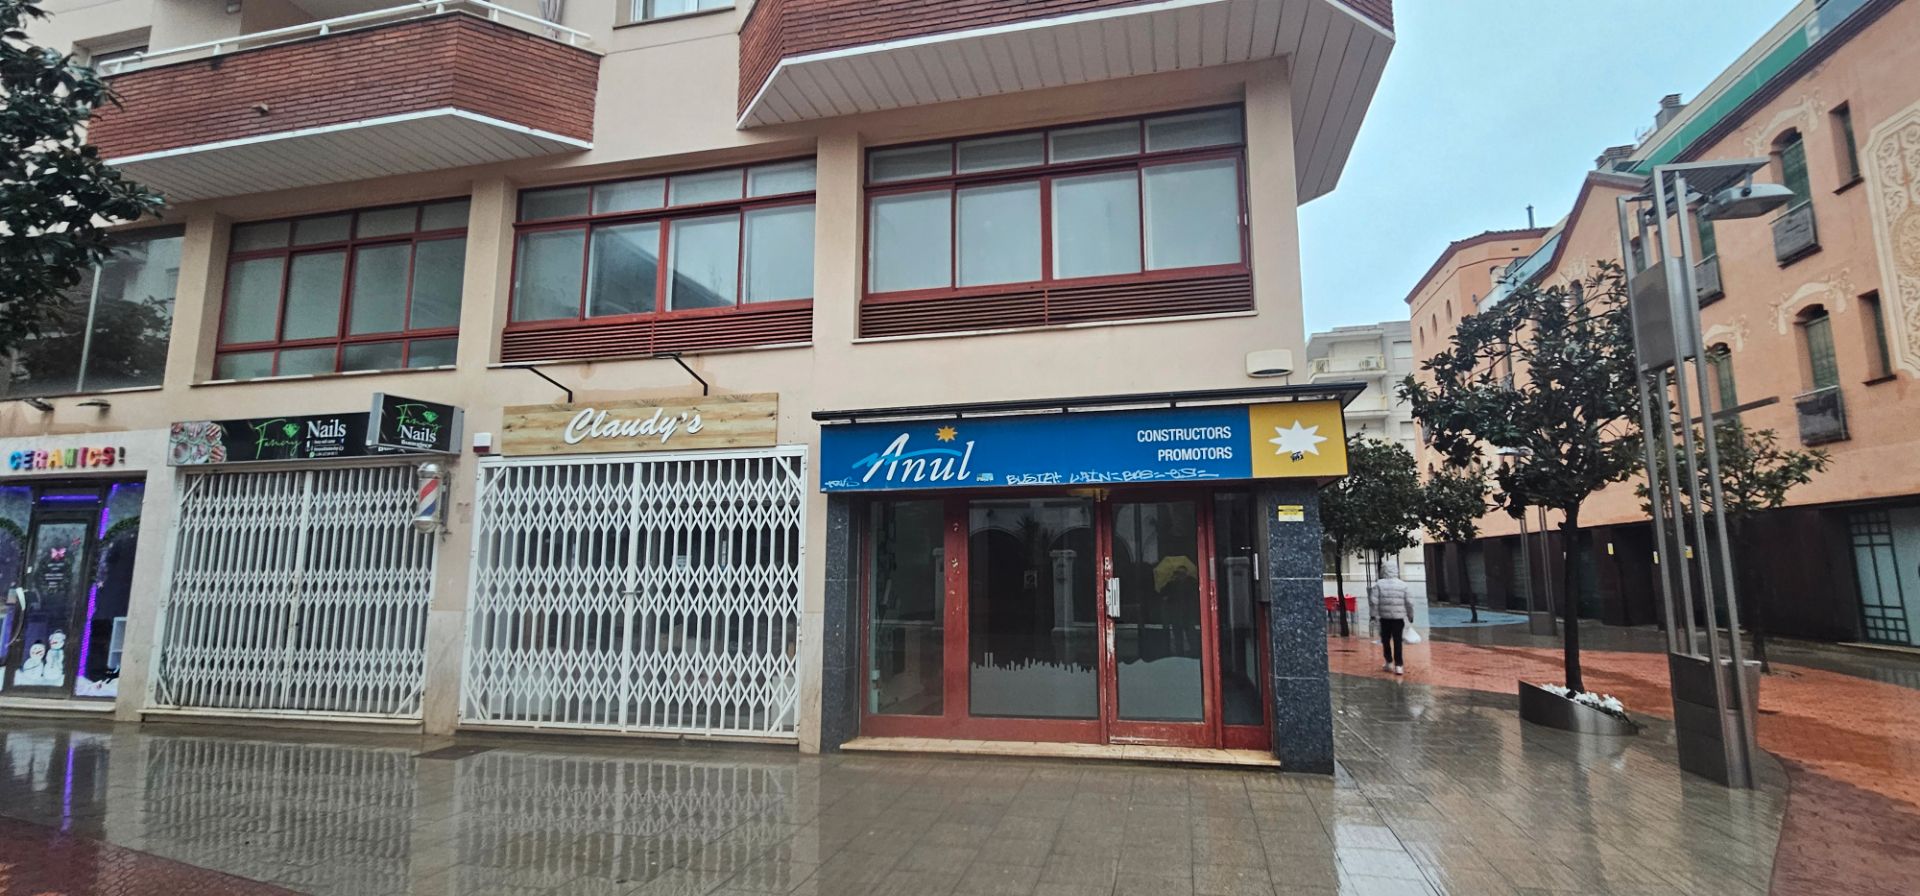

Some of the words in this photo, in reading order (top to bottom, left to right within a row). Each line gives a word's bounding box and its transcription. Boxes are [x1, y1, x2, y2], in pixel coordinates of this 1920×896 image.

[306, 419, 346, 438] Nails
[400, 425, 436, 442] Nails
[564, 407, 703, 444] Claudy's
[1137, 426, 1232, 442] CONSTRUCTORS
[8, 446, 125, 470] CERAMICS!
[863, 433, 975, 482] Anul
[1157, 446, 1233, 461] PROMOTORS
